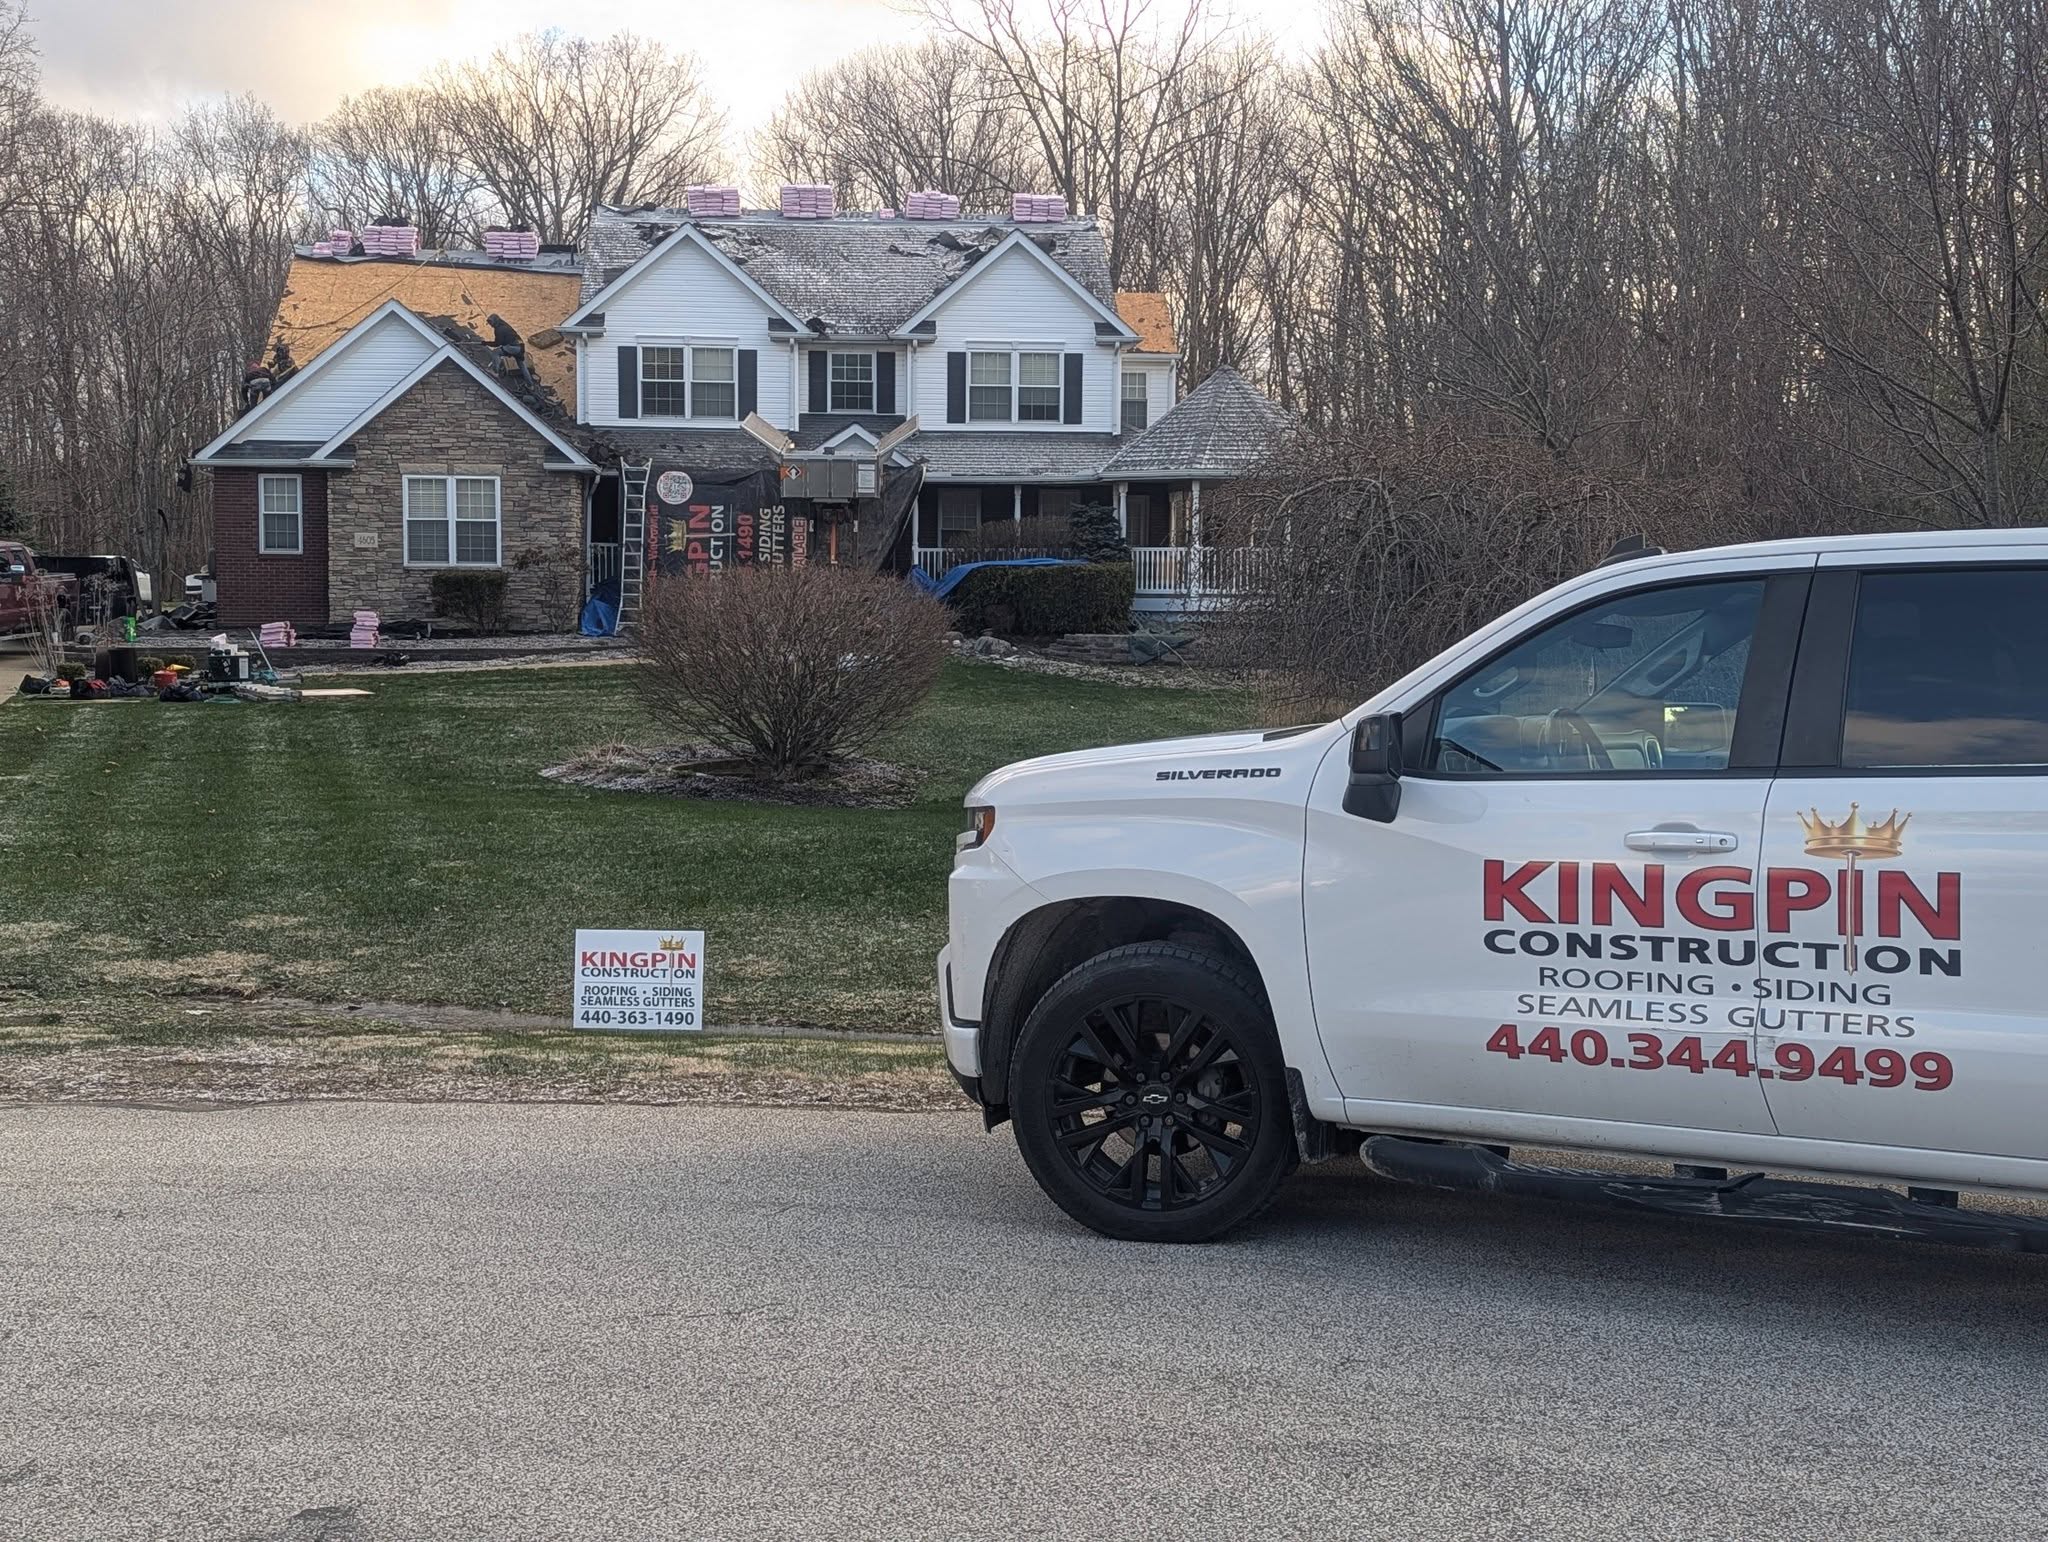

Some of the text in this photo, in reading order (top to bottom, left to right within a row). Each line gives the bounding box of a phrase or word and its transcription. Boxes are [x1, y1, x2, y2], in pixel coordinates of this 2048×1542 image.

[759, 508, 772, 562] SIDING
[1156, 768, 1281, 780] SILVERADO
[1483, 859, 1962, 941] KINGPIN
[582, 952, 696, 968] KINGPIN
[1483, 929, 1962, 977] CONSTRUCTION
[581, 967, 695, 979] CONSTRUCTION
[1538, 966, 1892, 1005] ROOFING SIDING
[580, 996, 695, 1008] SEAMLESS GUTTERS
[584, 985, 692, 997] ROOFING SIDING
[580, 1010, 695, 1025] 440-363-1490
[1517, 994, 1916, 1038] SEAMLESS GUTTERS
[1486, 1024, 1954, 1091] 440.344.9499
